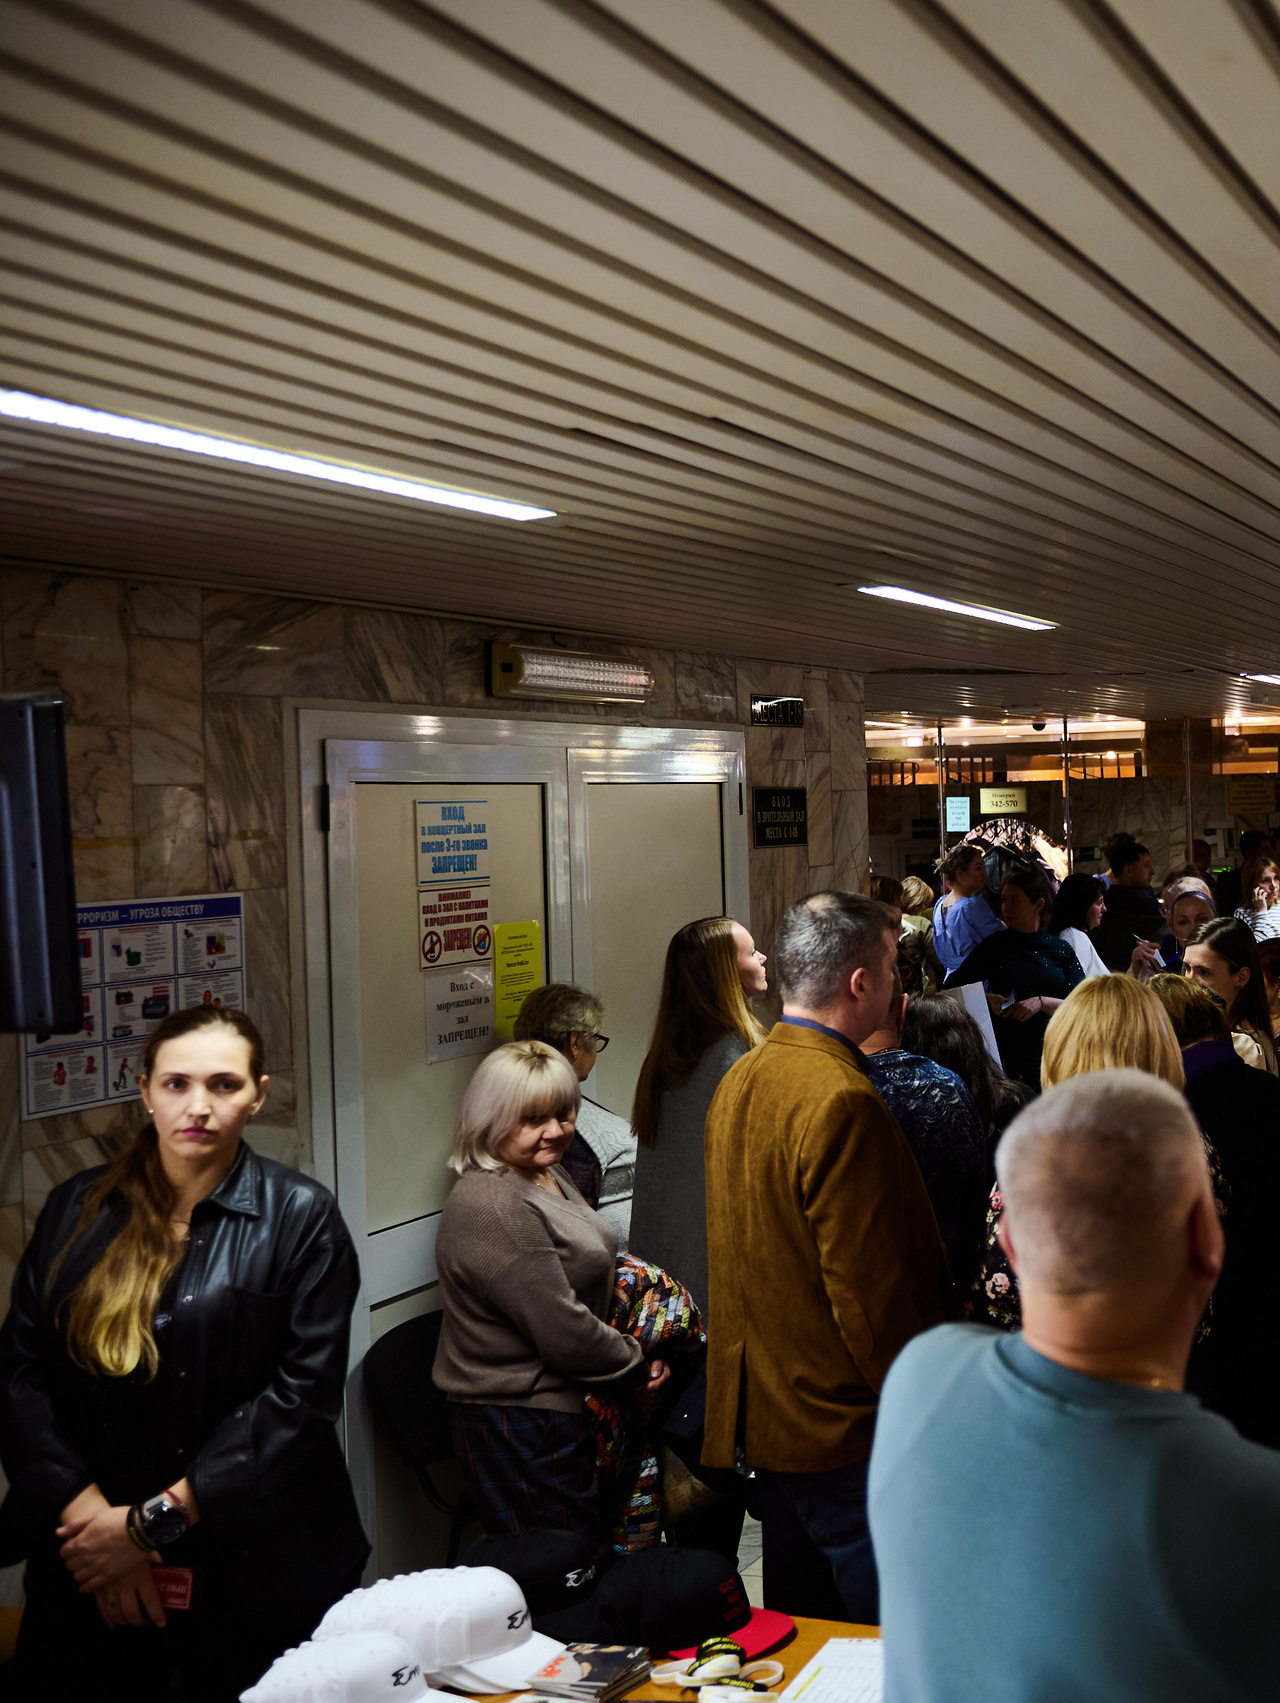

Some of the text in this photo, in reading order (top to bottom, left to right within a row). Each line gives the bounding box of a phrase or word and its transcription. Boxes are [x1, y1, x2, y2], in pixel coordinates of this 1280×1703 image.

[771, 795, 791, 808] ВХОД
[441, 806, 465, 822] ВХОД
[421, 841, 445, 854] после
[461, 838, 488, 851] звонка
[431, 854, 477, 875] ЗАПРЕЩЕН!
[438, 890, 471, 902] ВНИМАНИЕ!
[77, 910, 119, 925] РРОРИЗМ
[129, 907, 160, 920] УГРОЗА
[161, 904, 205, 918] ОБЩЕСТВУ
[422, 904, 438, 915] ВХОД
[443, 902, 453, 913] ЗАЛ
[458, 899, 489, 911] НАПИТКАМИ
[429, 914, 464, 927] ПРОДУКТАМИ
[450, 982, 475, 992] Вход с
[436, 997, 482, 1013] мороженым
[456, 1016, 469, 1025] зал
[437, 1026, 489, 1045] ЗАПРЕЩЕН!
